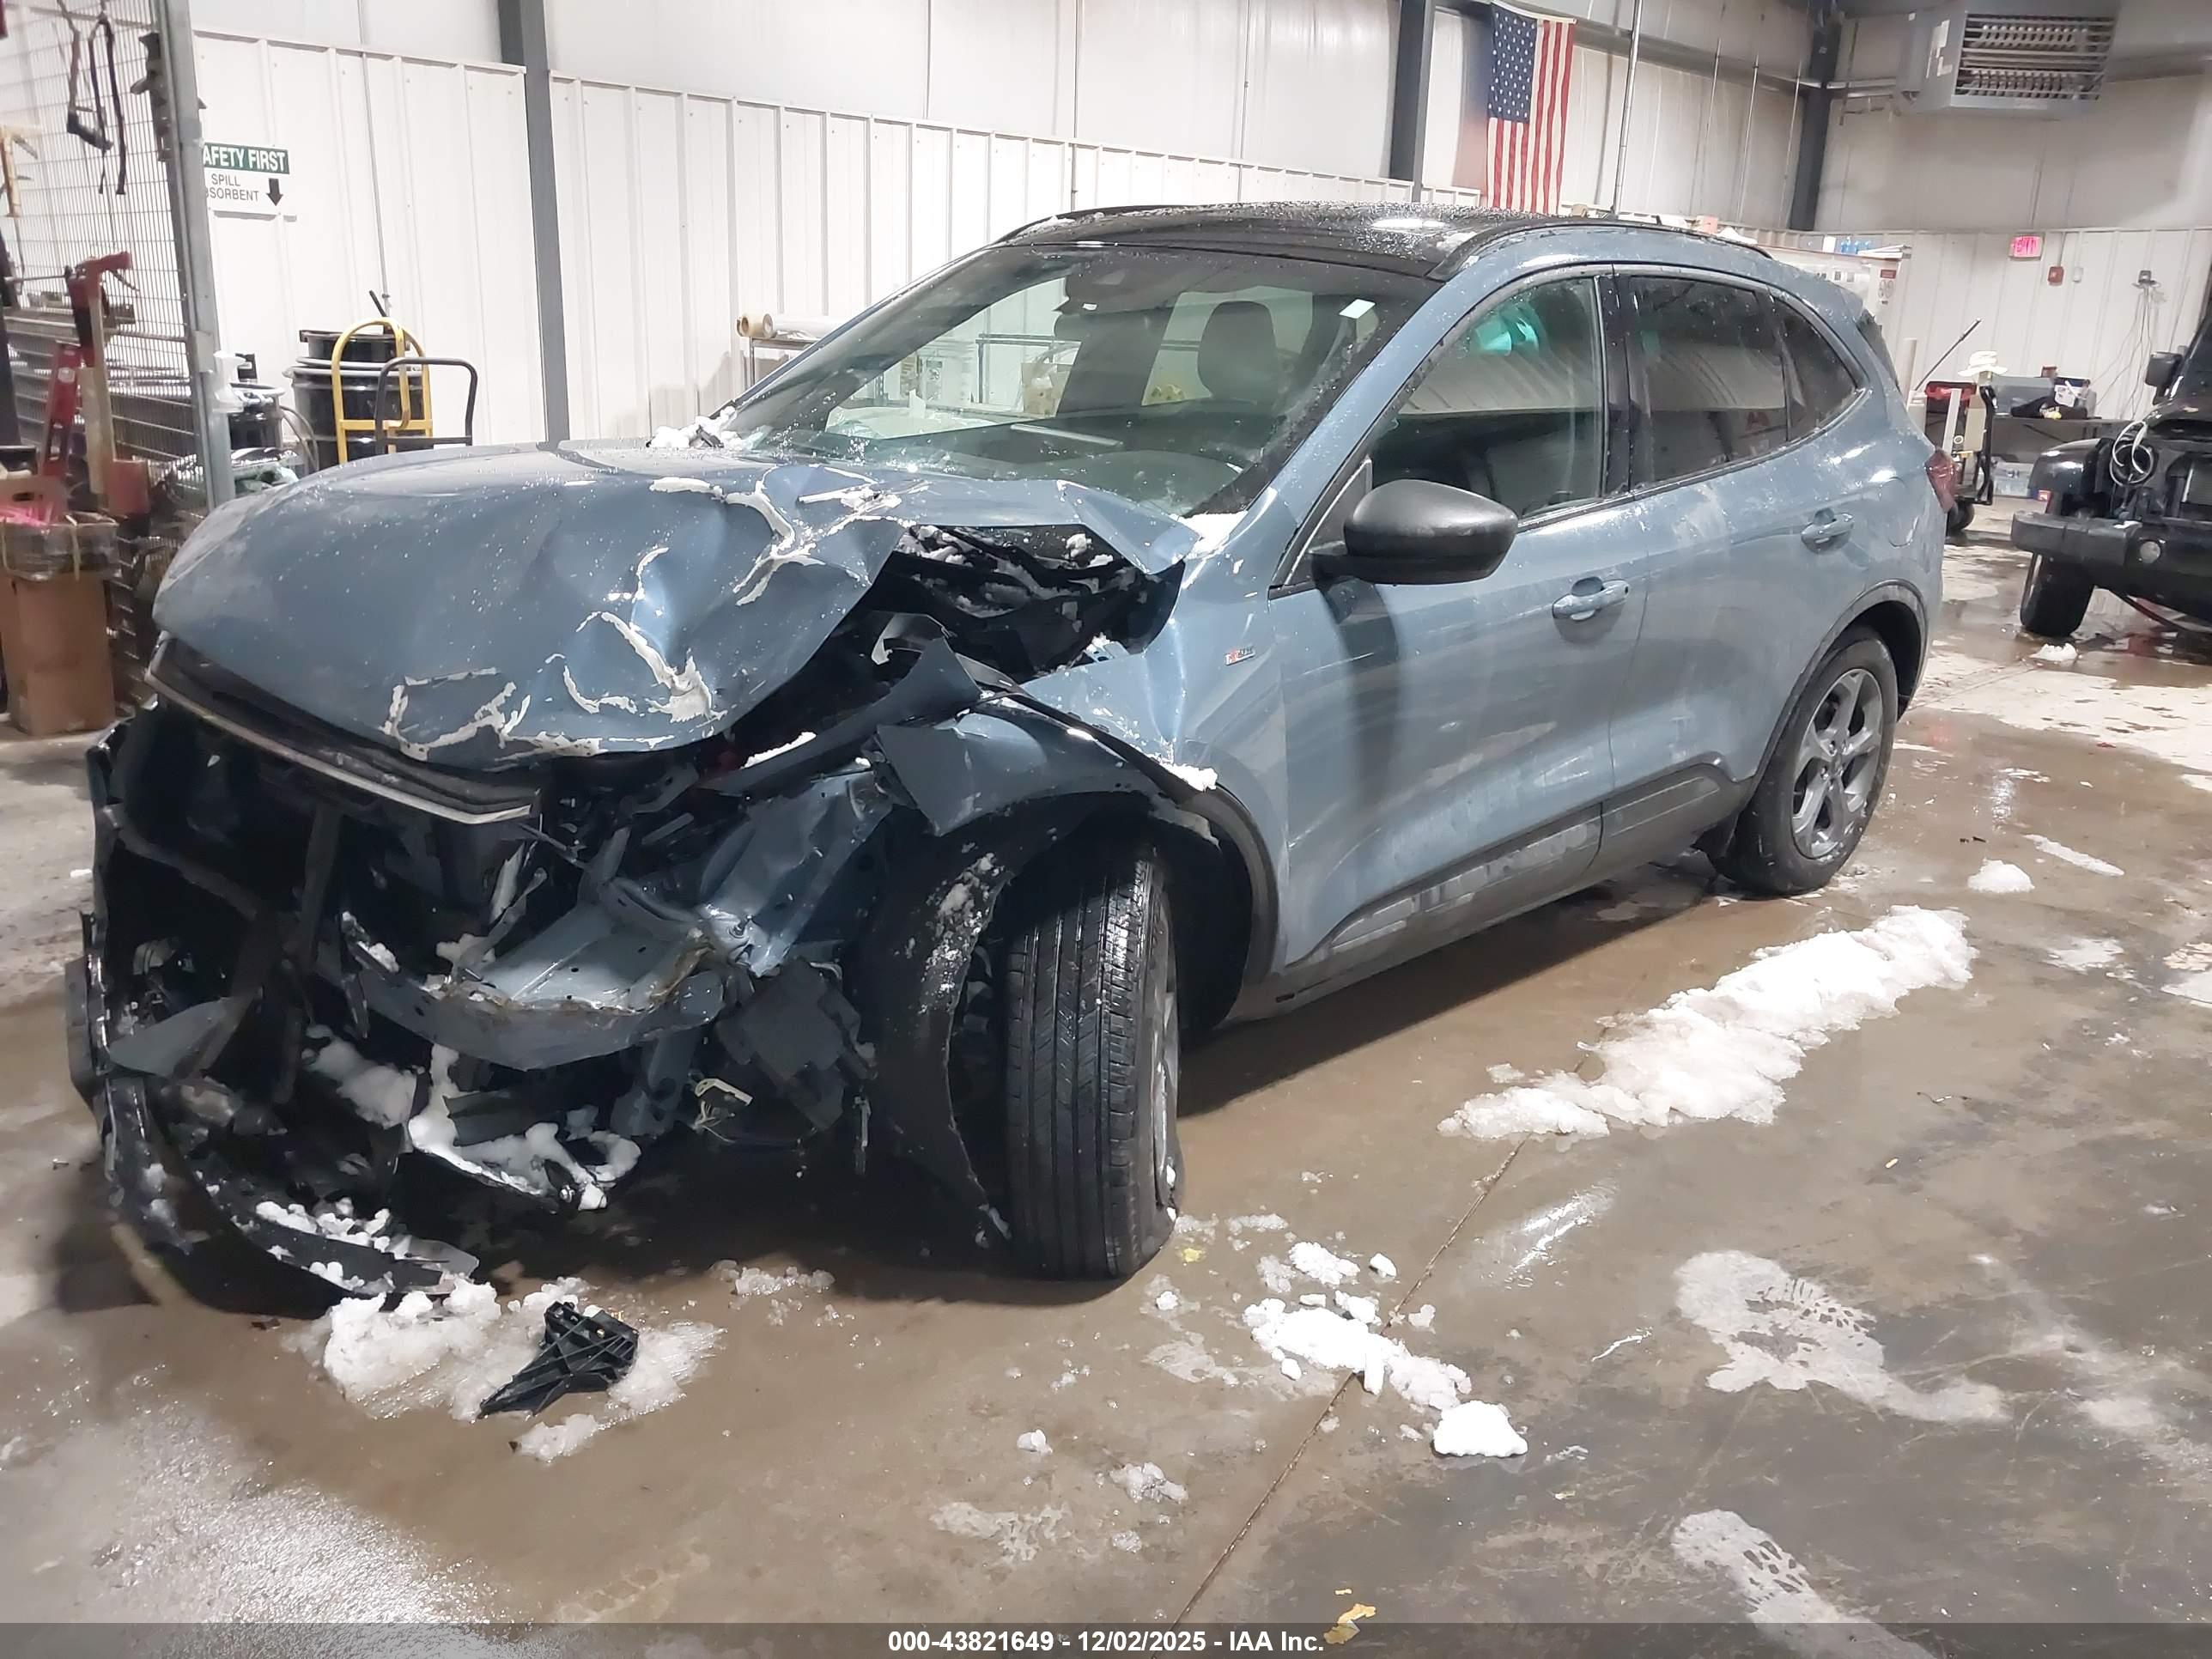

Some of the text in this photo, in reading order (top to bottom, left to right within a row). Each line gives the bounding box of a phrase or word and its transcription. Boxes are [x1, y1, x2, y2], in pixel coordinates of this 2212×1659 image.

[203, 145, 286, 171] AFETY FIRST
[211, 173, 240, 186] SPILL
[206, 187, 259, 201] SORBENT
